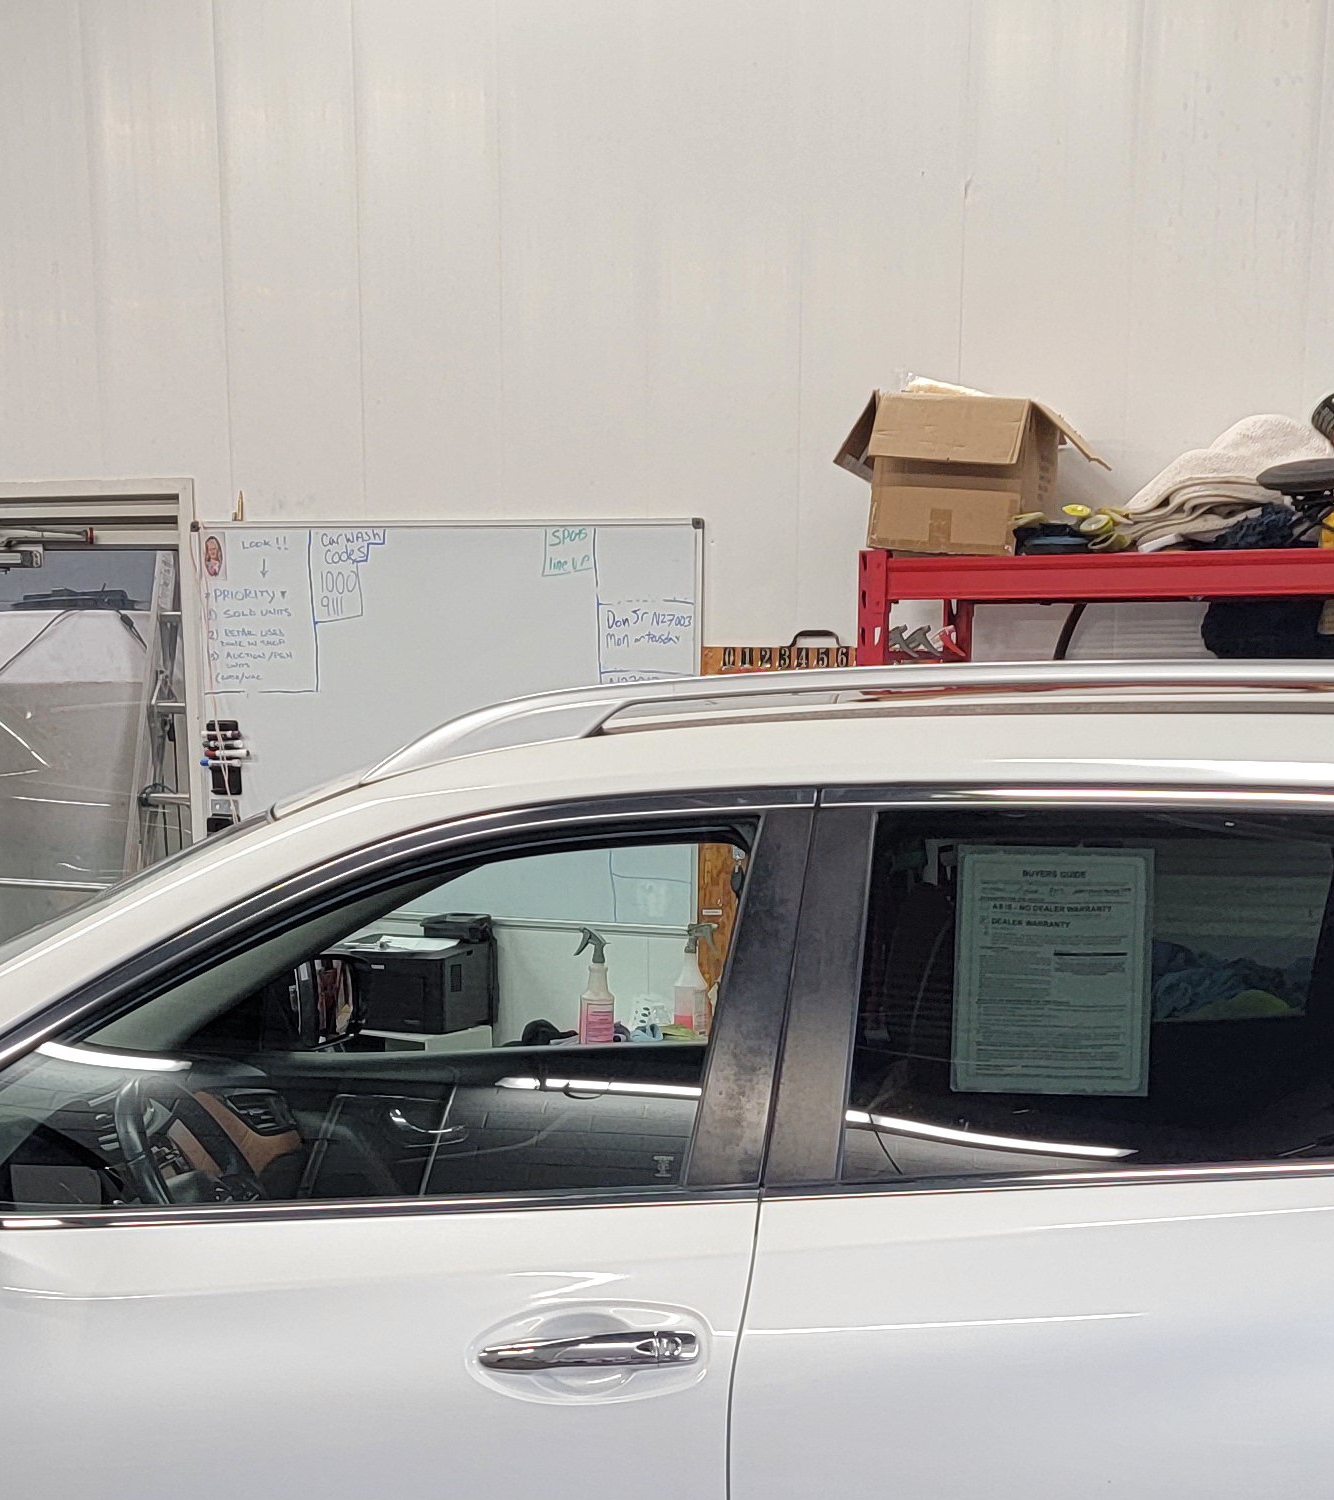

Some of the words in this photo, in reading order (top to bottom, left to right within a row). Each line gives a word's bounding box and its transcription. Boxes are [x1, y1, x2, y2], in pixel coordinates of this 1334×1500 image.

[320, 570, 358, 595] 1000
[213, 587, 276, 604] PRIORITY
[320, 595, 344, 617] 9111
[223, 607, 257, 619] SOLD
[606, 609, 630, 630] Don
[760, 648, 771, 668] 2
[780, 647, 791, 668] 3
[797, 647, 808, 668] 4
[818, 647, 828, 668] 5
[837, 647, 847, 668] 6
[1022, 869, 1058, 879] BUYERS
[1059, 870, 1087, 879] GUIDE
